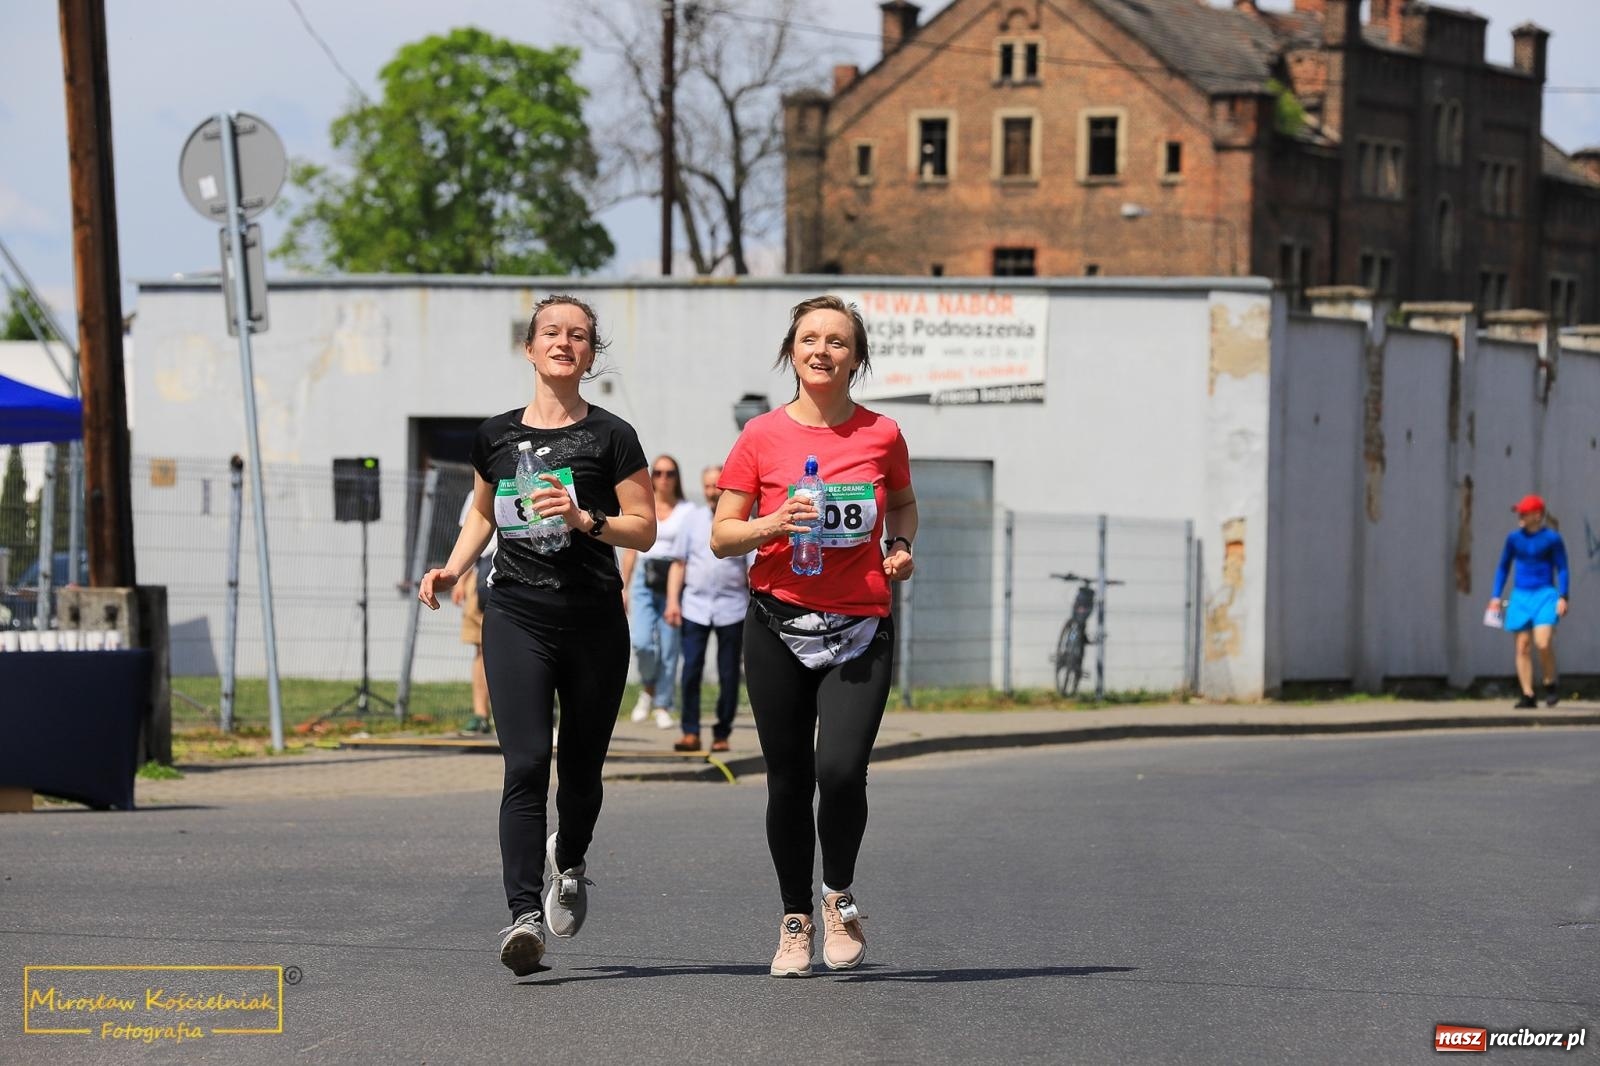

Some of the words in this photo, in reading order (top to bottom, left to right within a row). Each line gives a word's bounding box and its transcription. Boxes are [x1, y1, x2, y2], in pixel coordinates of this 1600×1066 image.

[862, 291, 929, 315] TRWA
[937, 289, 1015, 315] NABÓR
[866, 319, 904, 339] kcja
[912, 318, 1036, 339] Podnoszenia
[824, 503, 862, 530] 08
